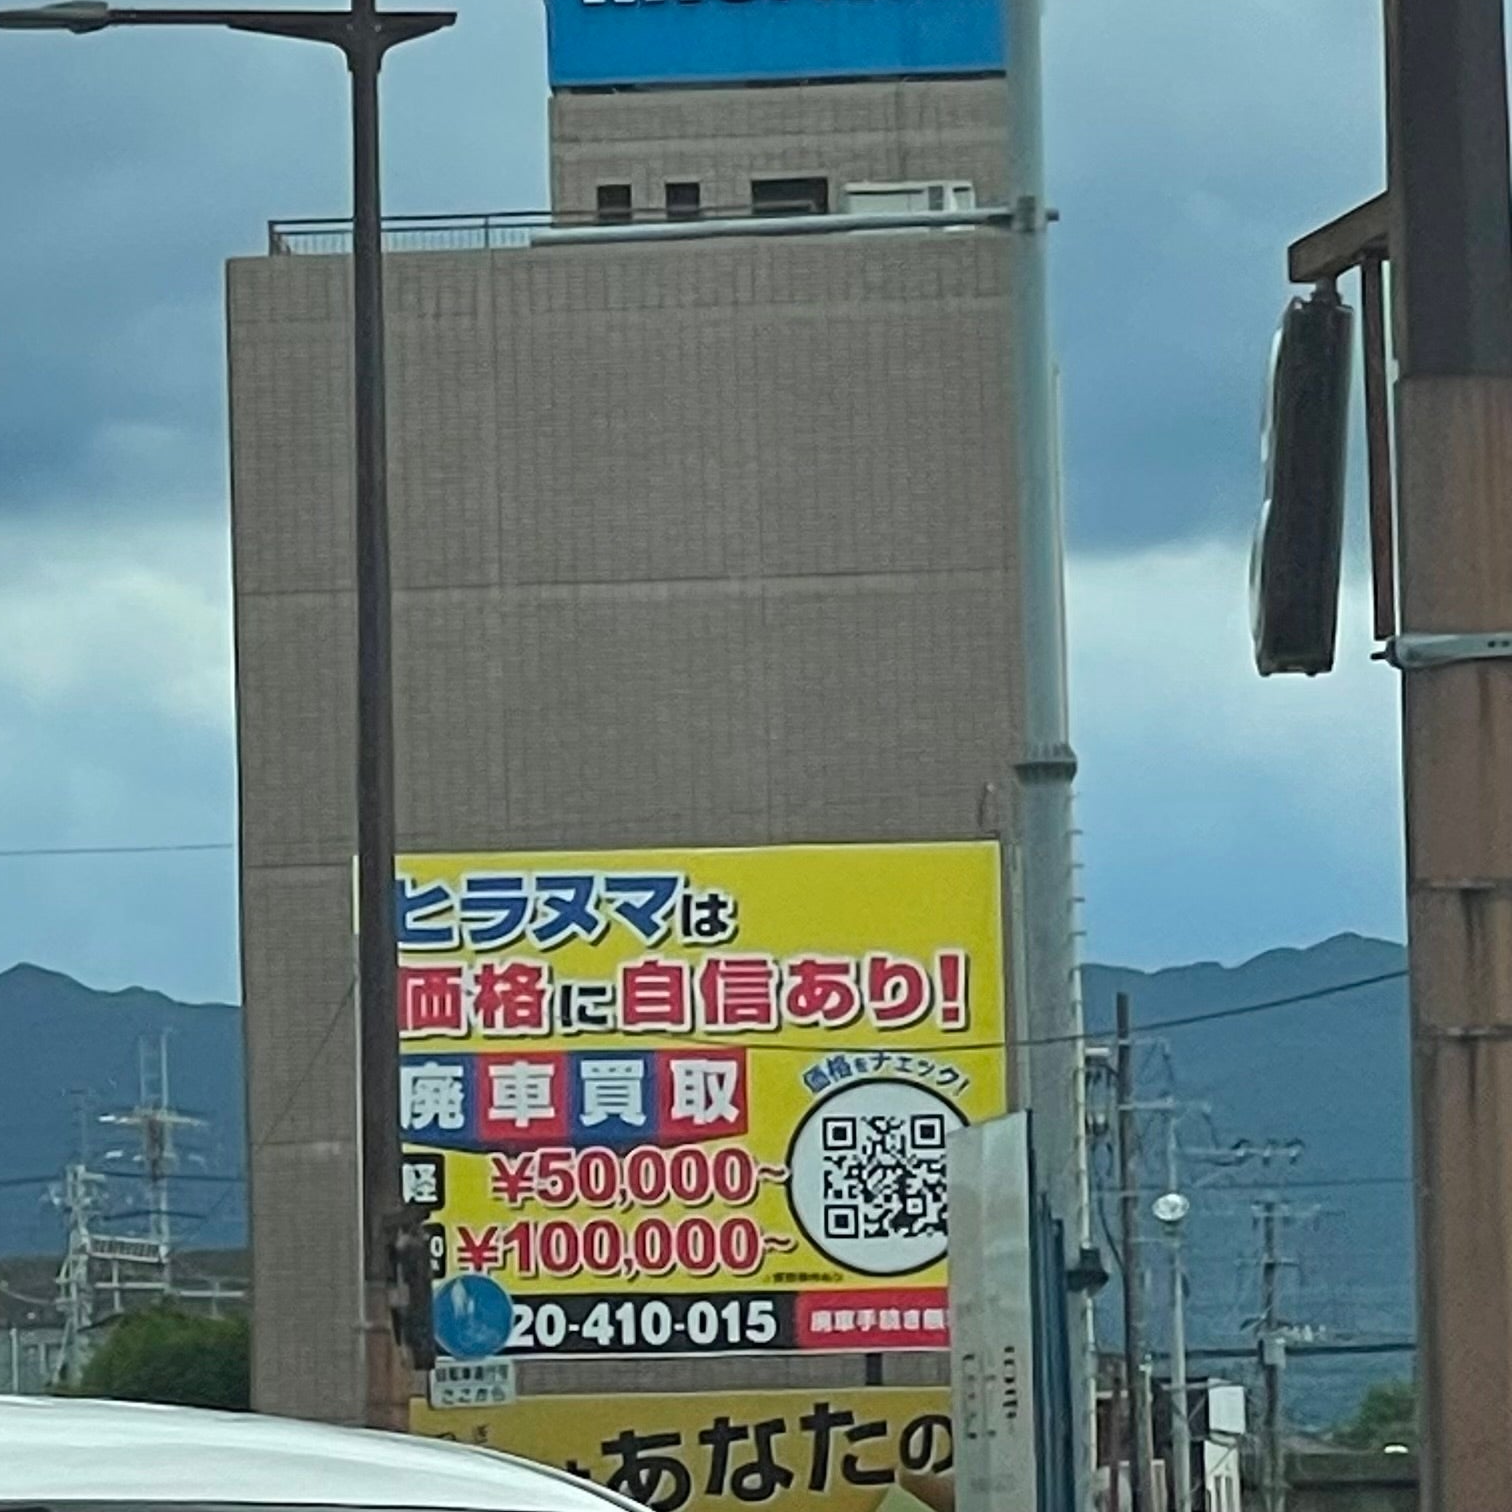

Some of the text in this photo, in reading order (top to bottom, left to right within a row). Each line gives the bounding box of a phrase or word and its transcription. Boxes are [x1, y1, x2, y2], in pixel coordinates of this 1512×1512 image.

[395, 874, 730, 943] ヒラヌマは
[398, 954, 962, 1031] 価格に自信あり!
[399, 1058, 740, 1130] 廃車買取
[566, 1401, 953, 1512] あなたの
